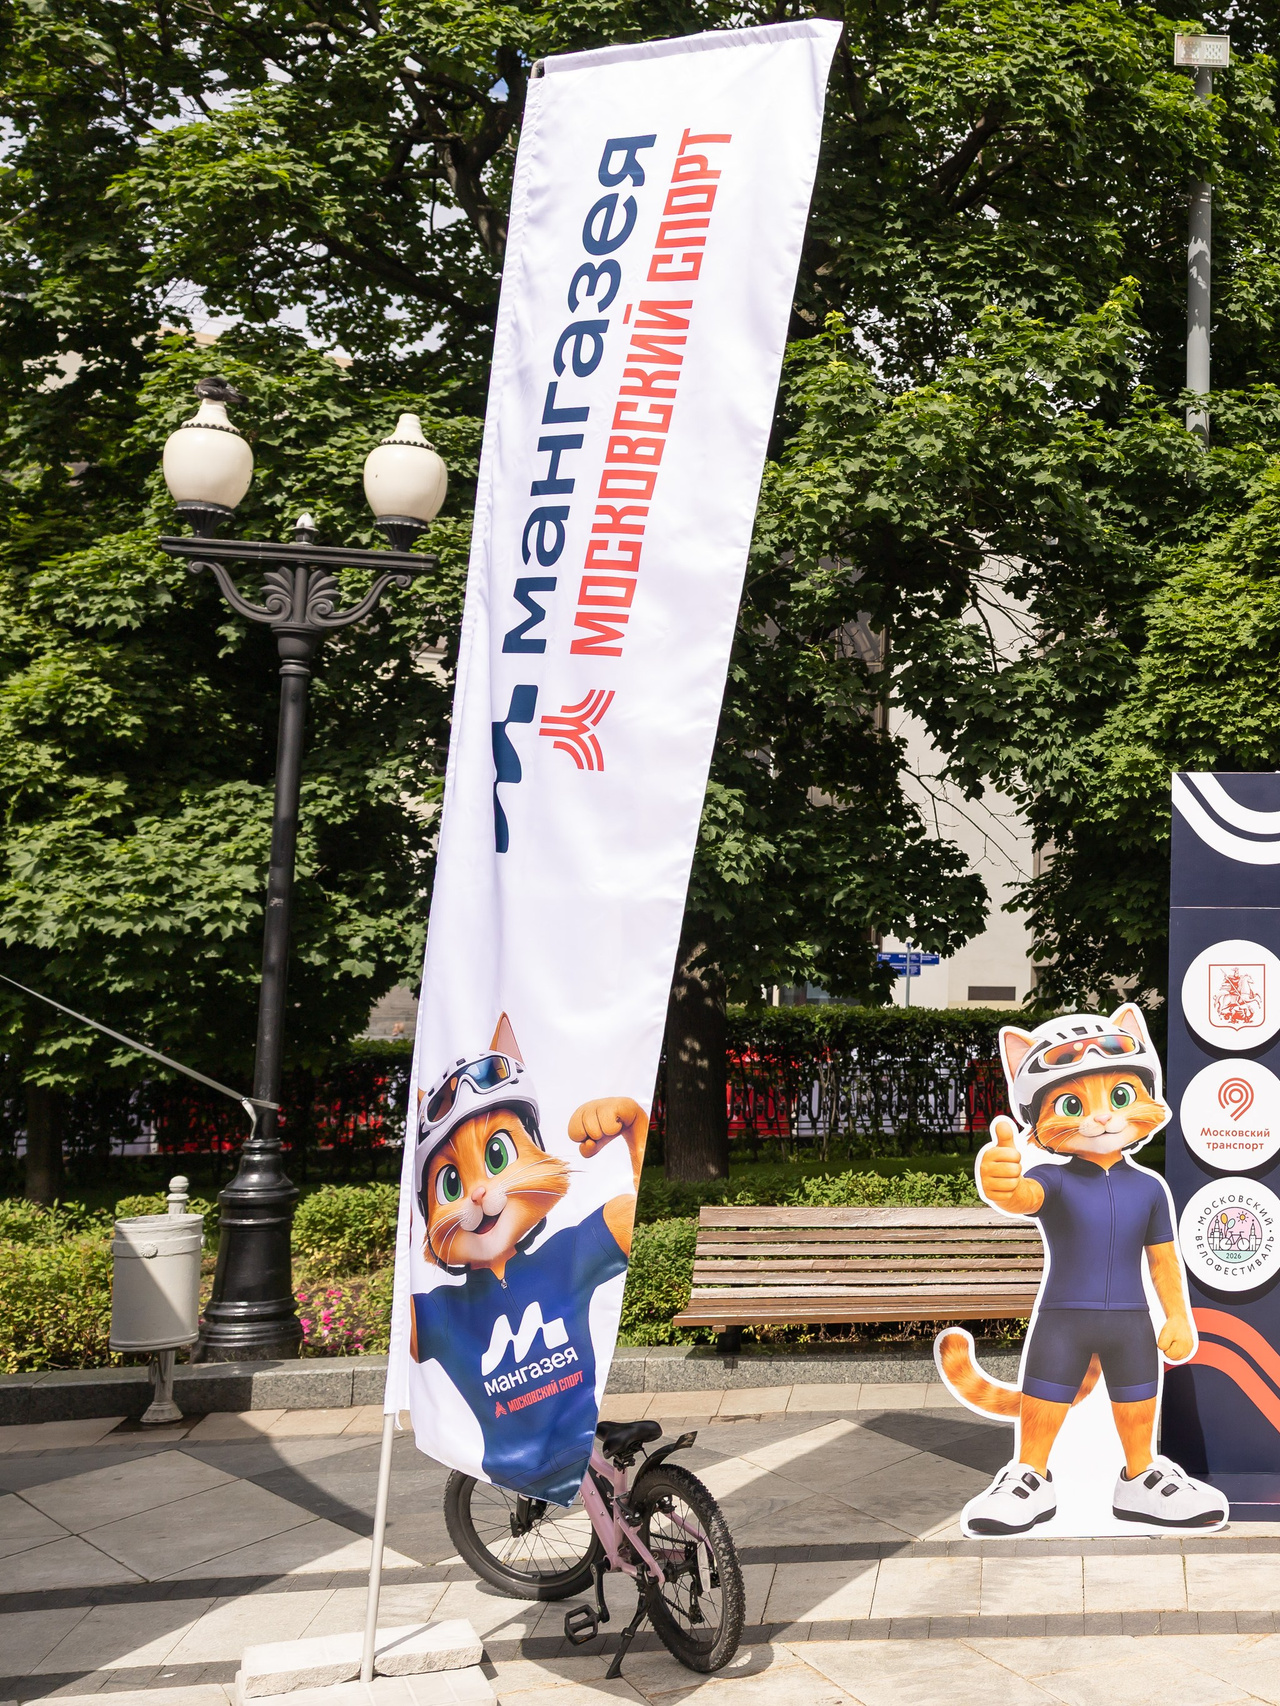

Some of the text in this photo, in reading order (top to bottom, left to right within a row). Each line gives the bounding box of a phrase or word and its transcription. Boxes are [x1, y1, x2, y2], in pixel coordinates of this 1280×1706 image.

[502, 133, 657, 654] мангазея
[570, 128, 732, 657] МОСКОВСКИЙ СПОРТ
[1200, 1127, 1270, 1138] Московский
[1206, 1141, 1264, 1152] транспорт
[1198, 1194, 1274, 1227] МОСКОВСКИЙ
[1195, 1235, 1275, 1277] ВЕЛОФЕСТИВАЛЬ
[1225, 1252, 1242, 1260] 2026
[483, 1346, 579, 1397] мангазея
[507, 1370, 584, 1413] МОСКОВСКИЙ СПОРТ
